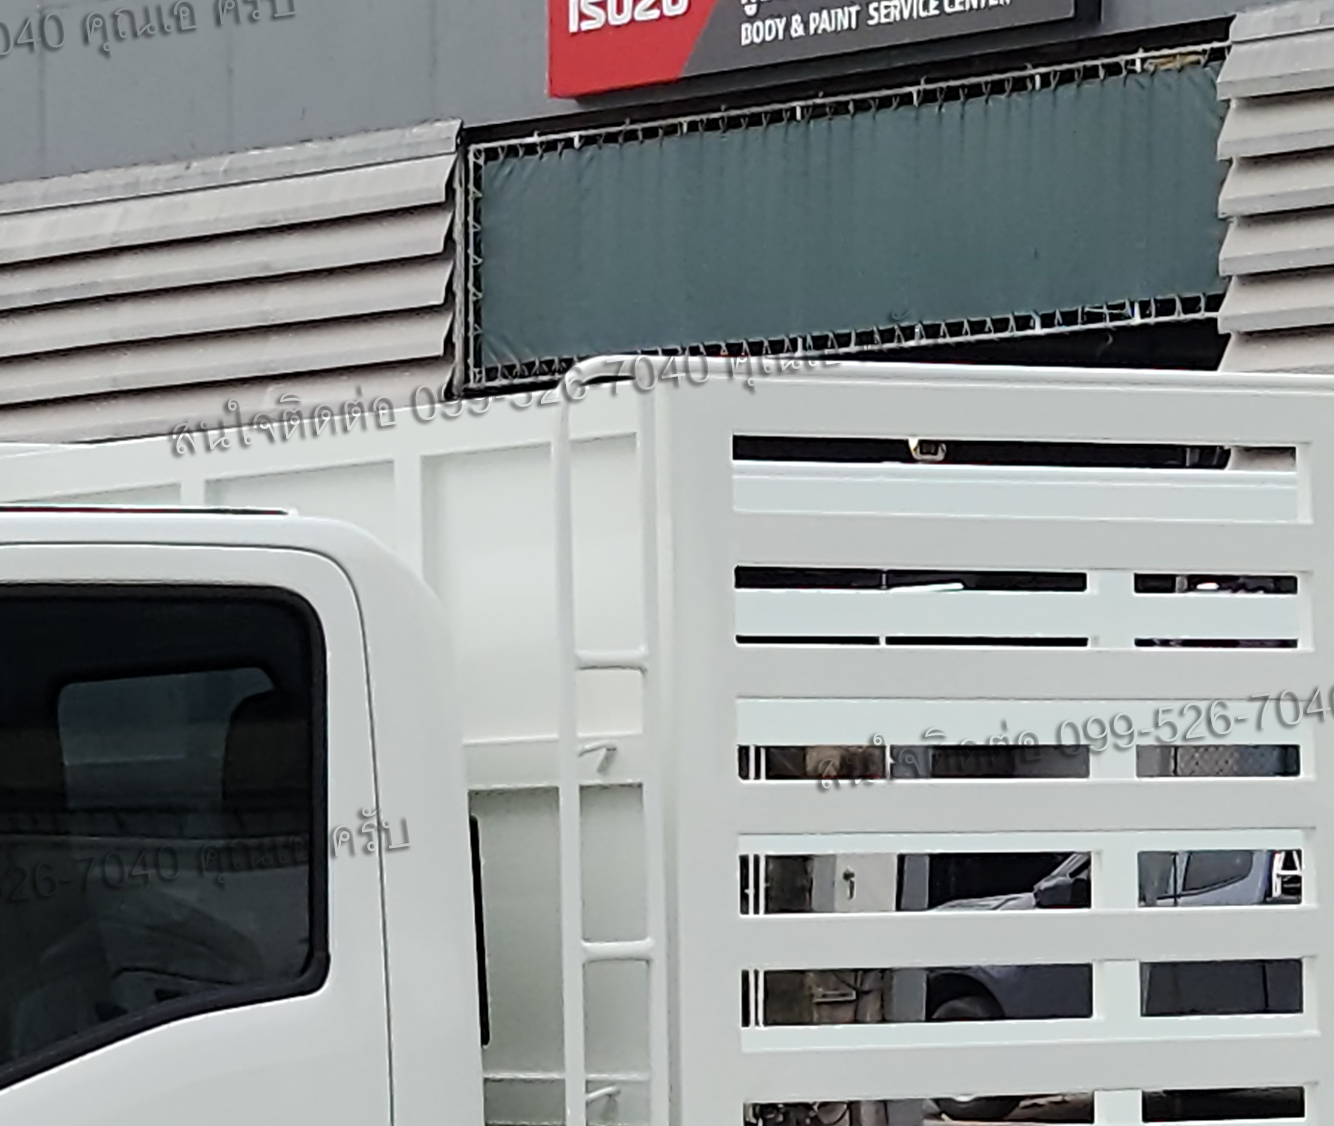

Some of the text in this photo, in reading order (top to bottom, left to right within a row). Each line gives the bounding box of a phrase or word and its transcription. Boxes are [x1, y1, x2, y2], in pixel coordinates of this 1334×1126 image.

[741, 17, 787, 46] BODY
[790, 14, 805, 38] &
[809, 5, 861, 35] PAINT
[866, 0, 940, 26] SERVICE
